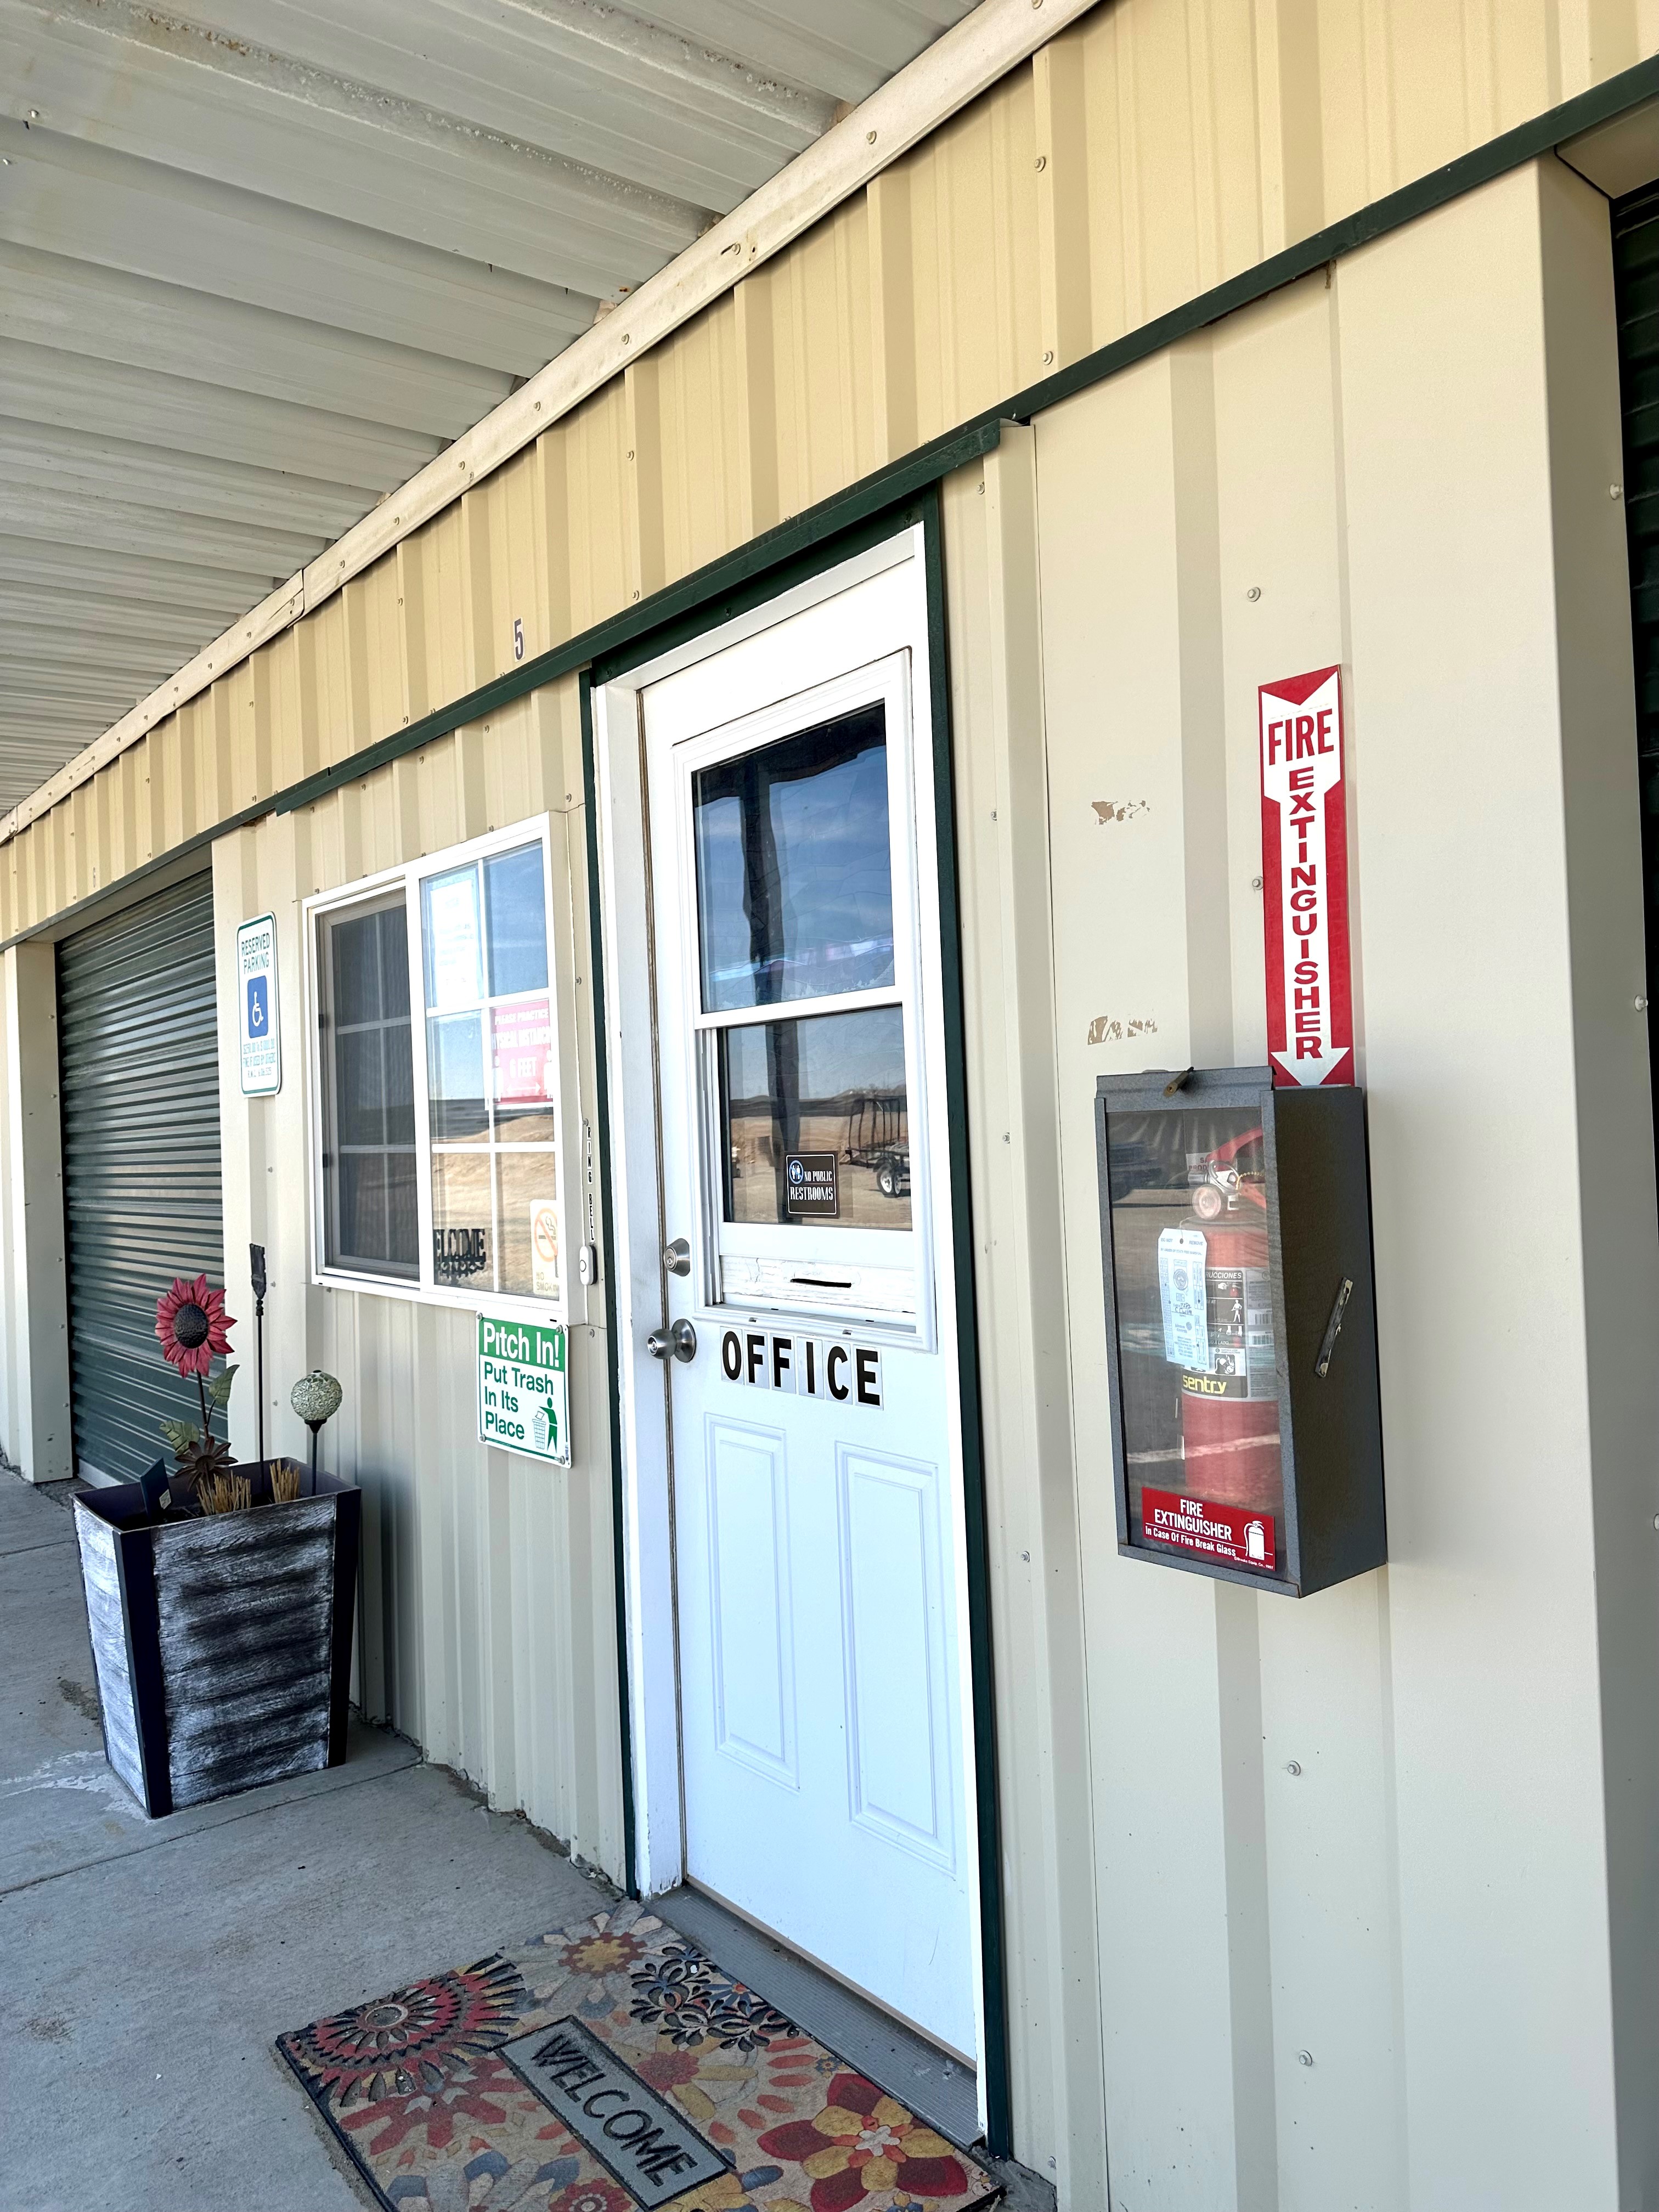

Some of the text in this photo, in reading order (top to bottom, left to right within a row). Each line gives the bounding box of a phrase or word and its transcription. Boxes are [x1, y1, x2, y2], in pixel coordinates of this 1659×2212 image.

[514, 618, 523, 660] 5
[1268, 708, 1334, 766] FIRE
[1289, 766, 1323, 1060] EXTINGUISHER
[241, 933, 270, 957] RESERVED
[244, 952, 269, 974] PARKING
[494, 1008, 549, 1025] PLEASE PRACTICE
[509, 1057, 537, 1079] 6 FEET
[804, 1171, 832, 1182] NO PUBLIC
[790, 1187, 833, 1200] RESTROOMS
[536, 1272, 544, 1280] NO
[536, 1282, 558, 1292] SMOKIN
[483, 1321, 560, 1368] Pitch In!
[484, 1361, 554, 1395] Put Trash
[722, 1330, 881, 1406] OFFICE
[1182, 1375, 1227, 1395] sentry
[484, 1386, 518, 1413] In Its
[486, 1411, 525, 1440] Place
[1180, 1498, 1204, 1518] FIRE
[1154, 1508, 1232, 1541] EXTINGUISHER
[1146, 1525, 1236, 1556] In Case Of Fire Break Glass
[531, 2034, 698, 2187] WELCOME
